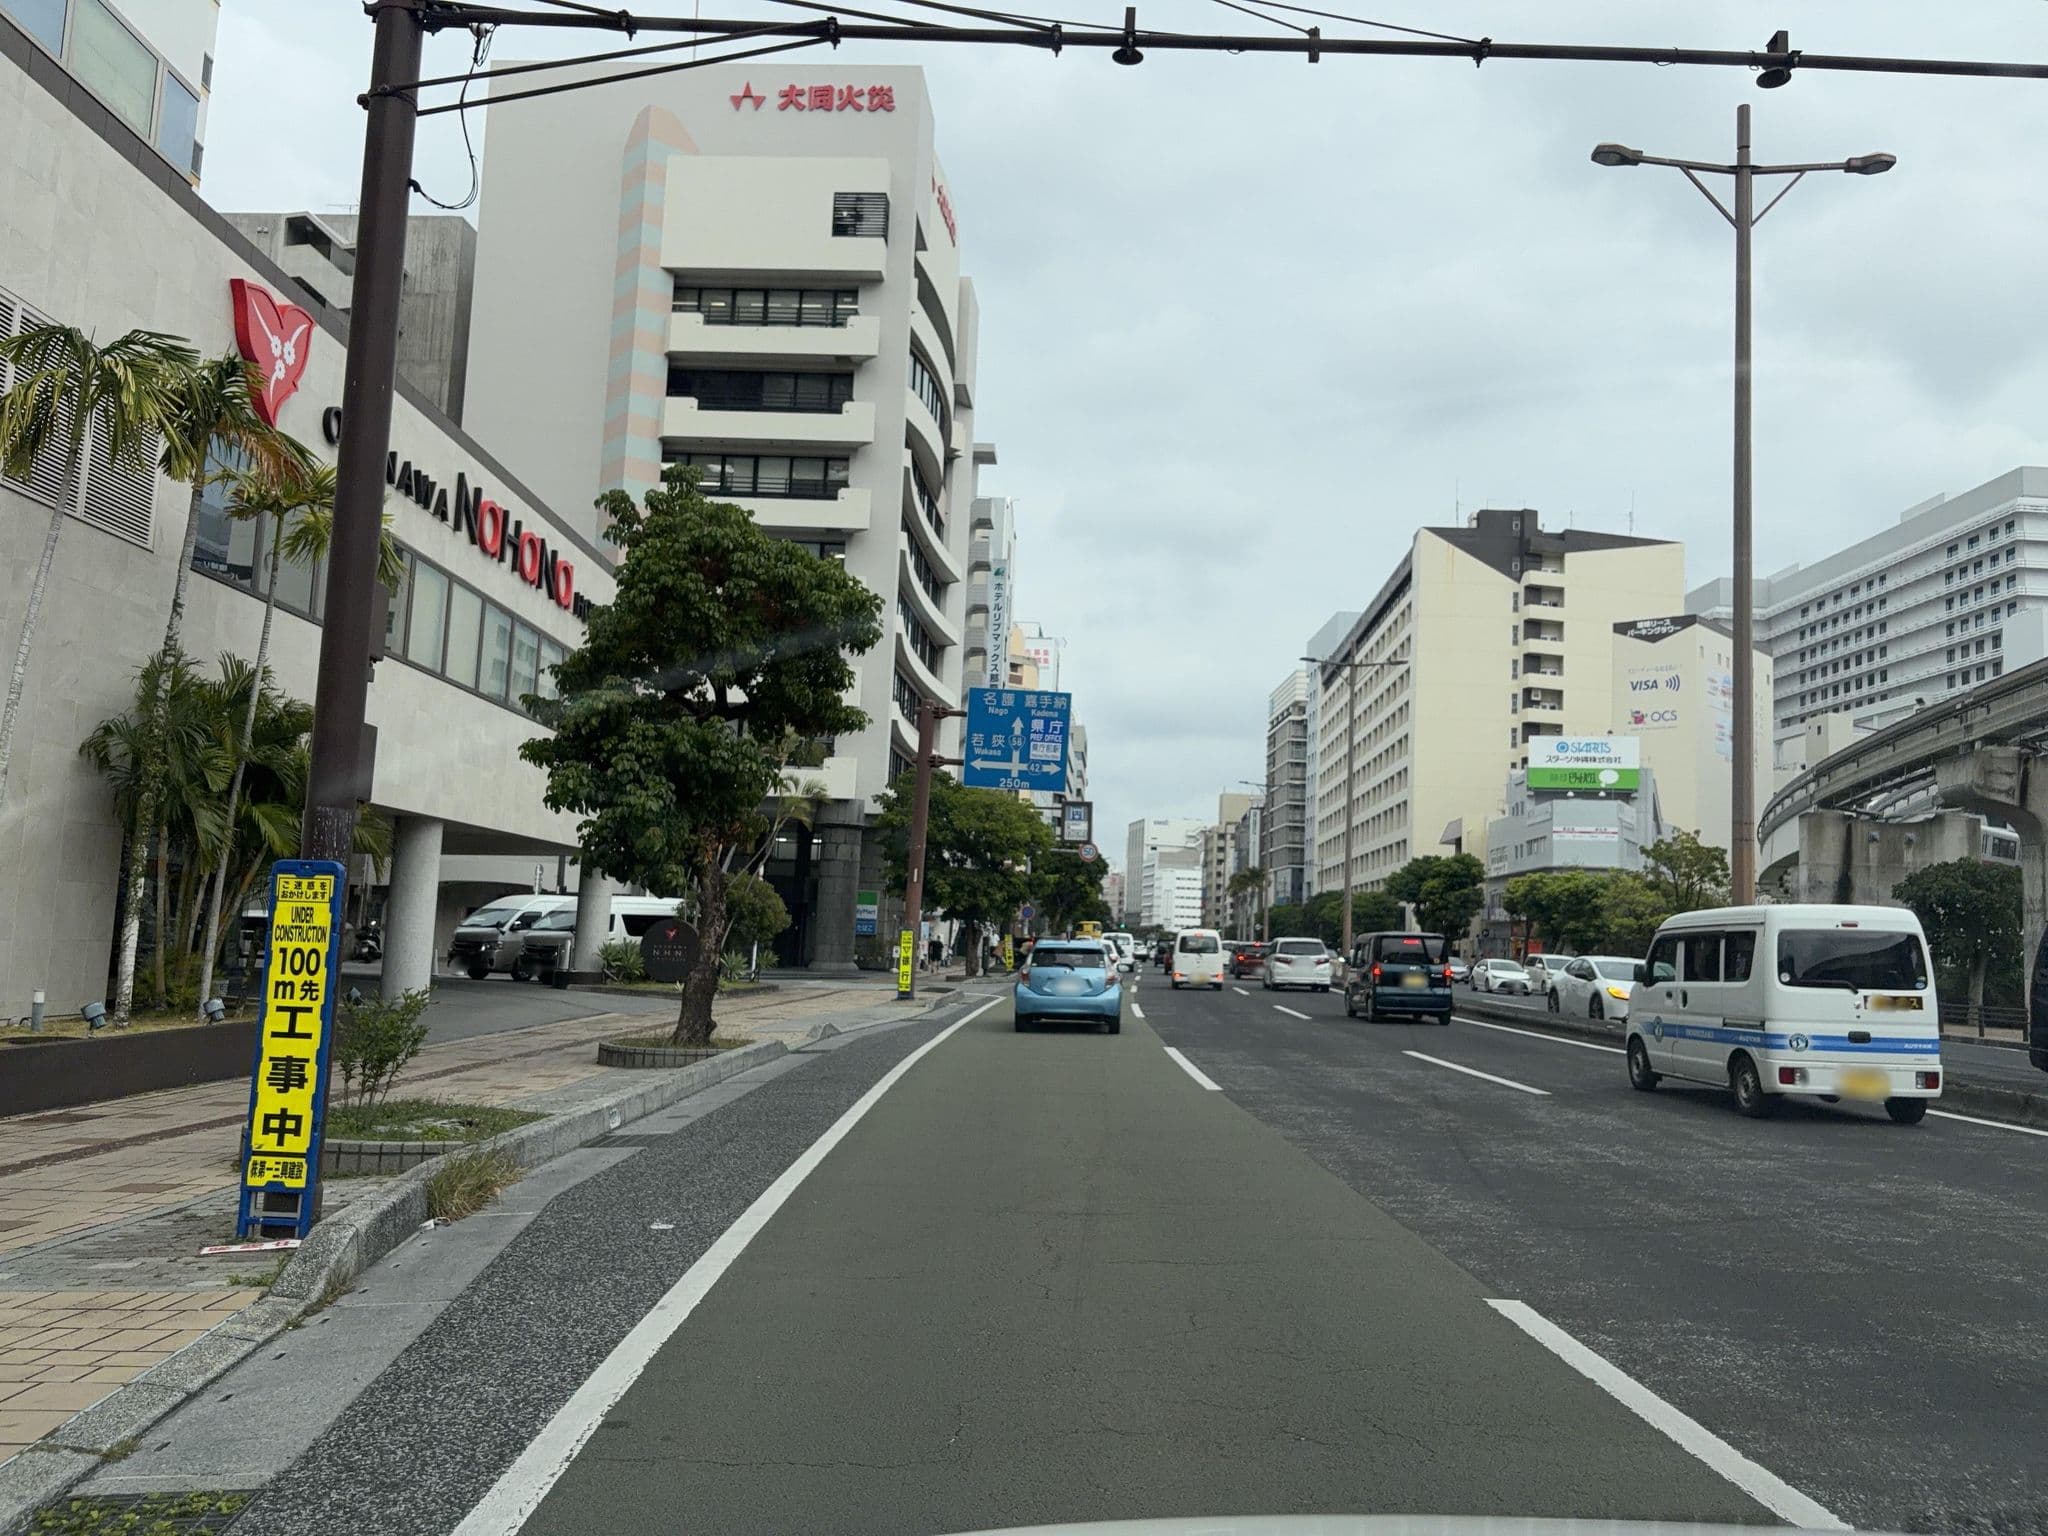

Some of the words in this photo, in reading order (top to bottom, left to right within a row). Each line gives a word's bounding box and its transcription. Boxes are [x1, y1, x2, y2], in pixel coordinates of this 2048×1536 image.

[777, 84, 896, 113] 大同火災
[322, 406, 449, 522] ONAWA
[1627, 626, 1681, 637] パーキングタワー
[1630, 680, 1658, 691] VISA
[983, 692, 1015, 707] 名護
[1025, 694, 1067, 710] 嘉手納
[988, 706, 1008, 716] Nago
[1651, 710, 1677, 721] OCS
[1031, 719, 1063, 734] 県庁
[971, 733, 1005, 748] 若狭
[1029, 763, 1040, 771] 42
[1000, 778, 1030, 789] 250m
[282, 880, 328, 891] ご迷惑を
[281, 890, 328, 900] おかけします
[291, 906, 314, 924] UNDER
[274, 925, 327, 943] CONSTRUCTION
[278, 947, 321, 977] 100
[273, 979, 320, 1001] m先
[261, 1005, 314, 1148] 工事中
